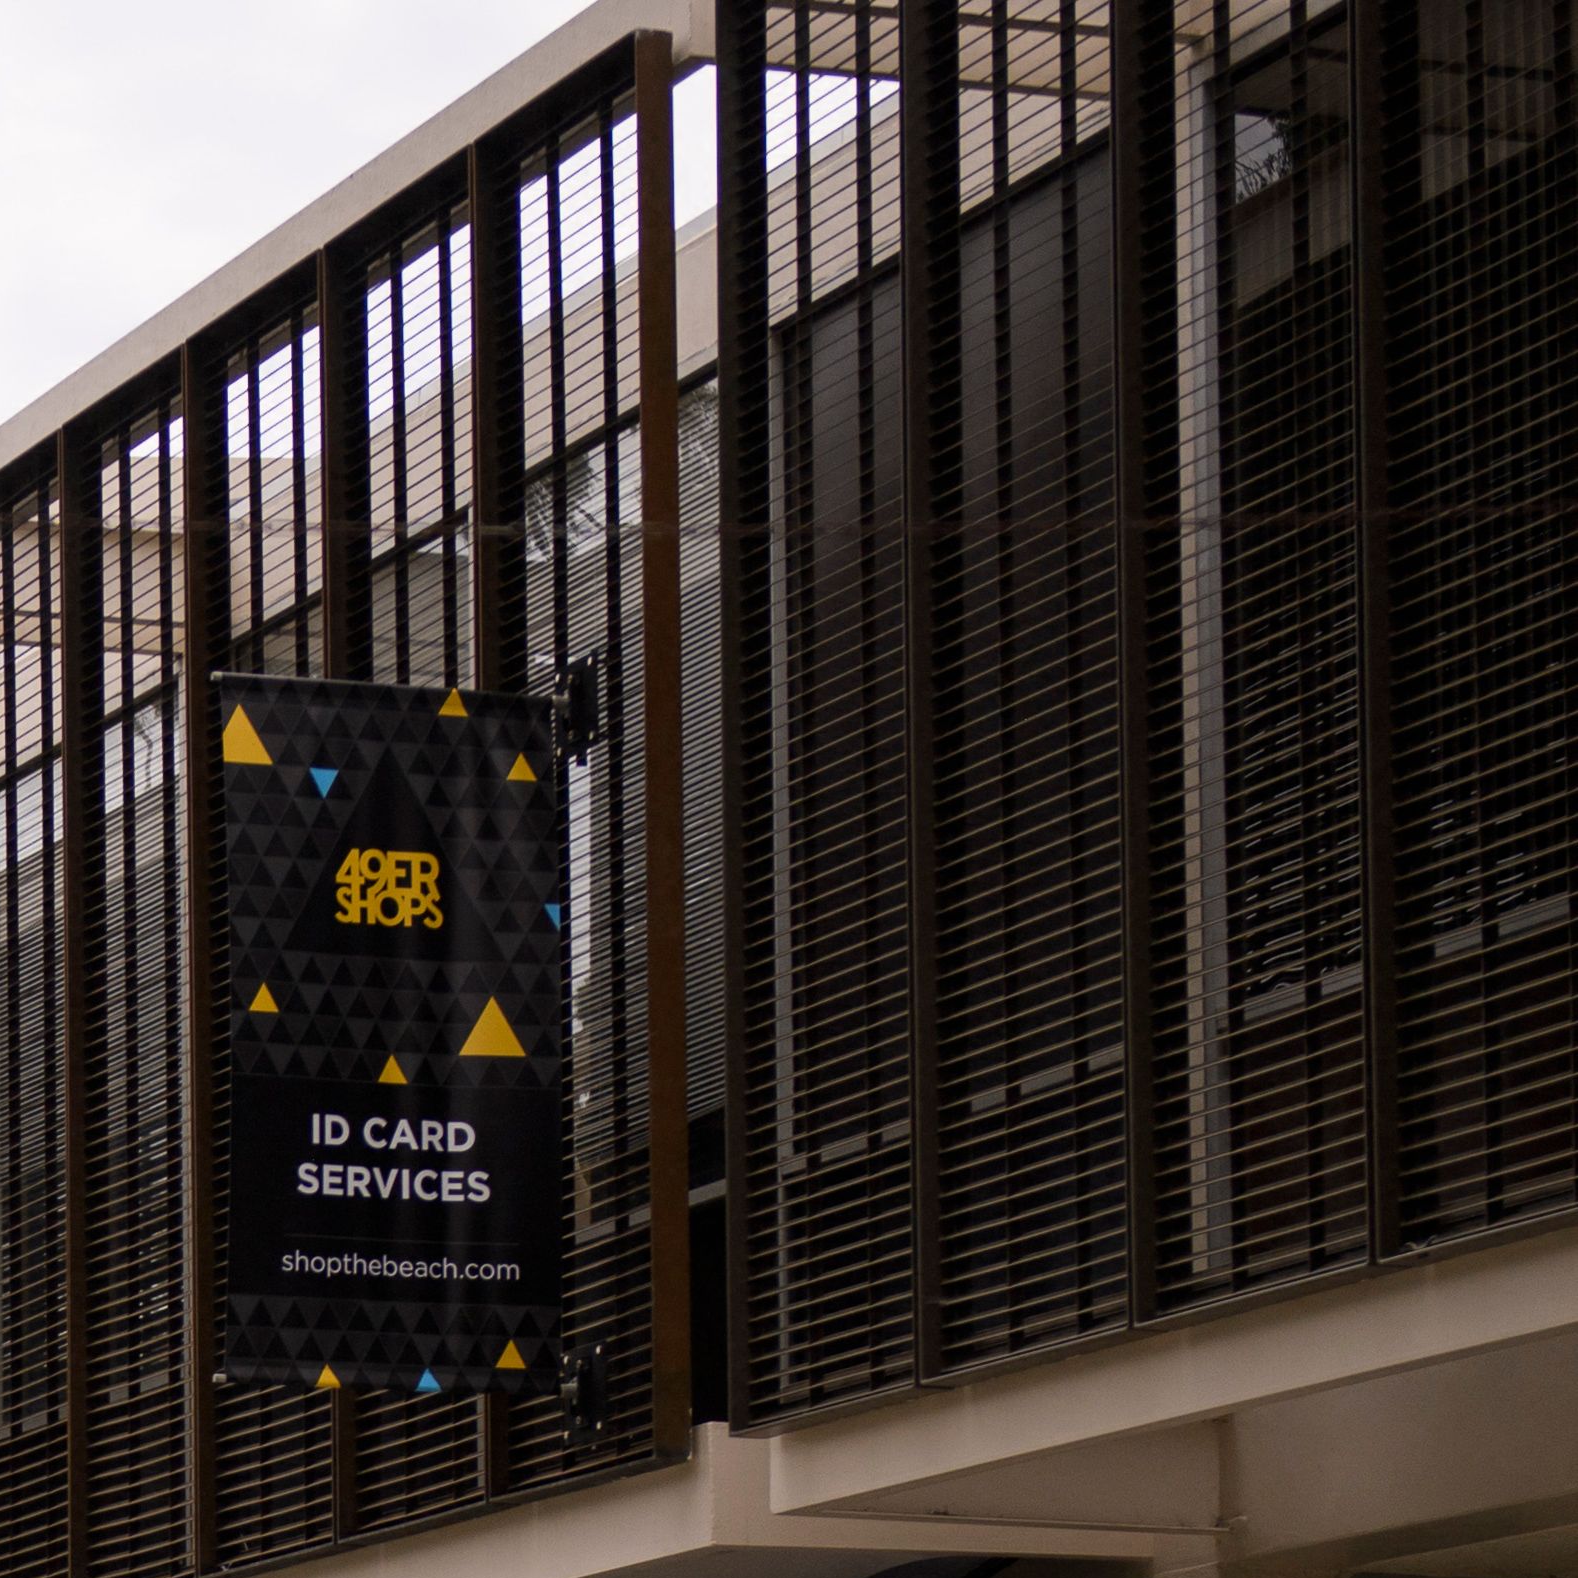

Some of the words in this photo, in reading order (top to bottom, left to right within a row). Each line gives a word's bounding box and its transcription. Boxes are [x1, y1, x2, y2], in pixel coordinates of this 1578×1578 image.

[336, 848, 440, 898] 49ER
[335, 887, 443, 930] SHOPS
[311, 1113, 349, 1147] ID
[362, 1116, 476, 1153] CARD
[297, 1162, 491, 1203] SERVICES
[281, 1250, 520, 1281] shopthebeach.com
